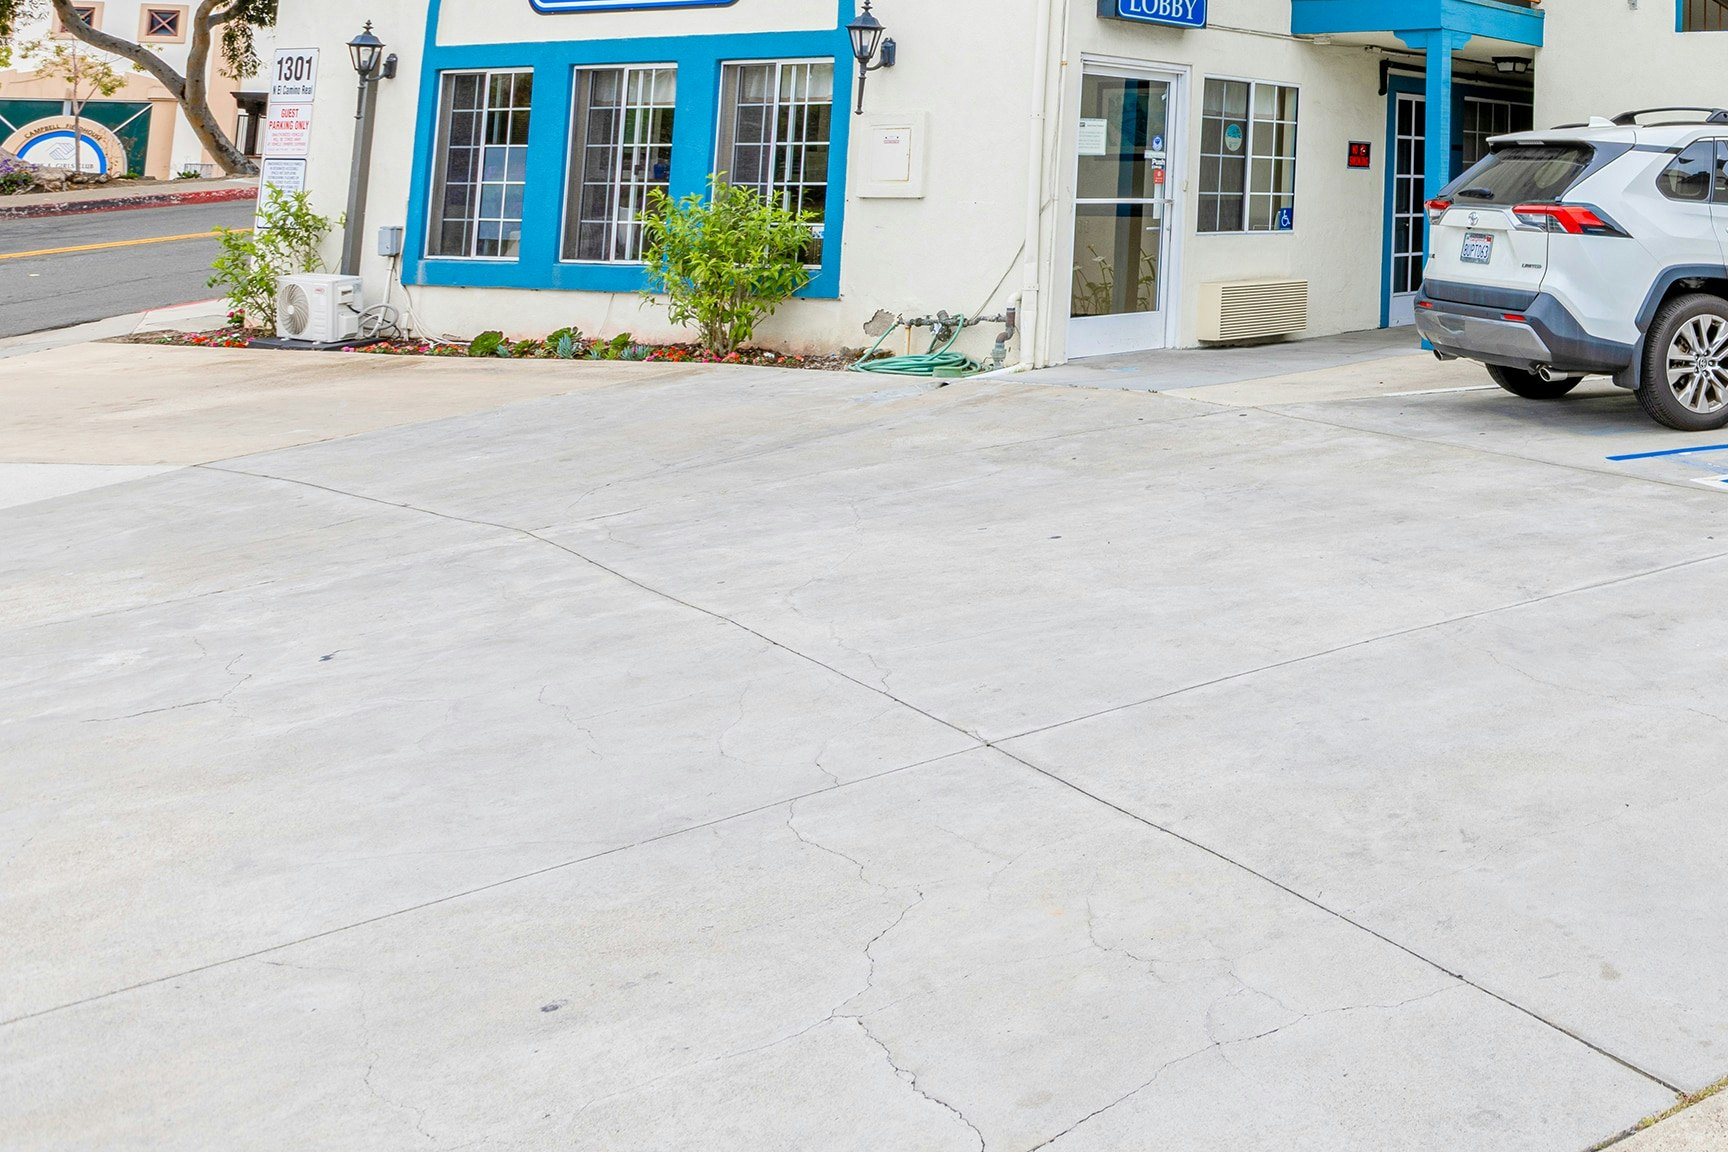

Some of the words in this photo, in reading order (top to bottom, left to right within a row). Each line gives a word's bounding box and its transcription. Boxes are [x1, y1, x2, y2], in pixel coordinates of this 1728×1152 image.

[277, 56, 313, 81] 1301
[283, 85, 300, 95] Camino
[301, 84, 313, 95] Real
[281, 108, 299, 118] GUEST
[268, 120, 294, 130] PARKING
[294, 120, 310, 130] ONLY
[24, 124, 60, 139] CAMPBELL
